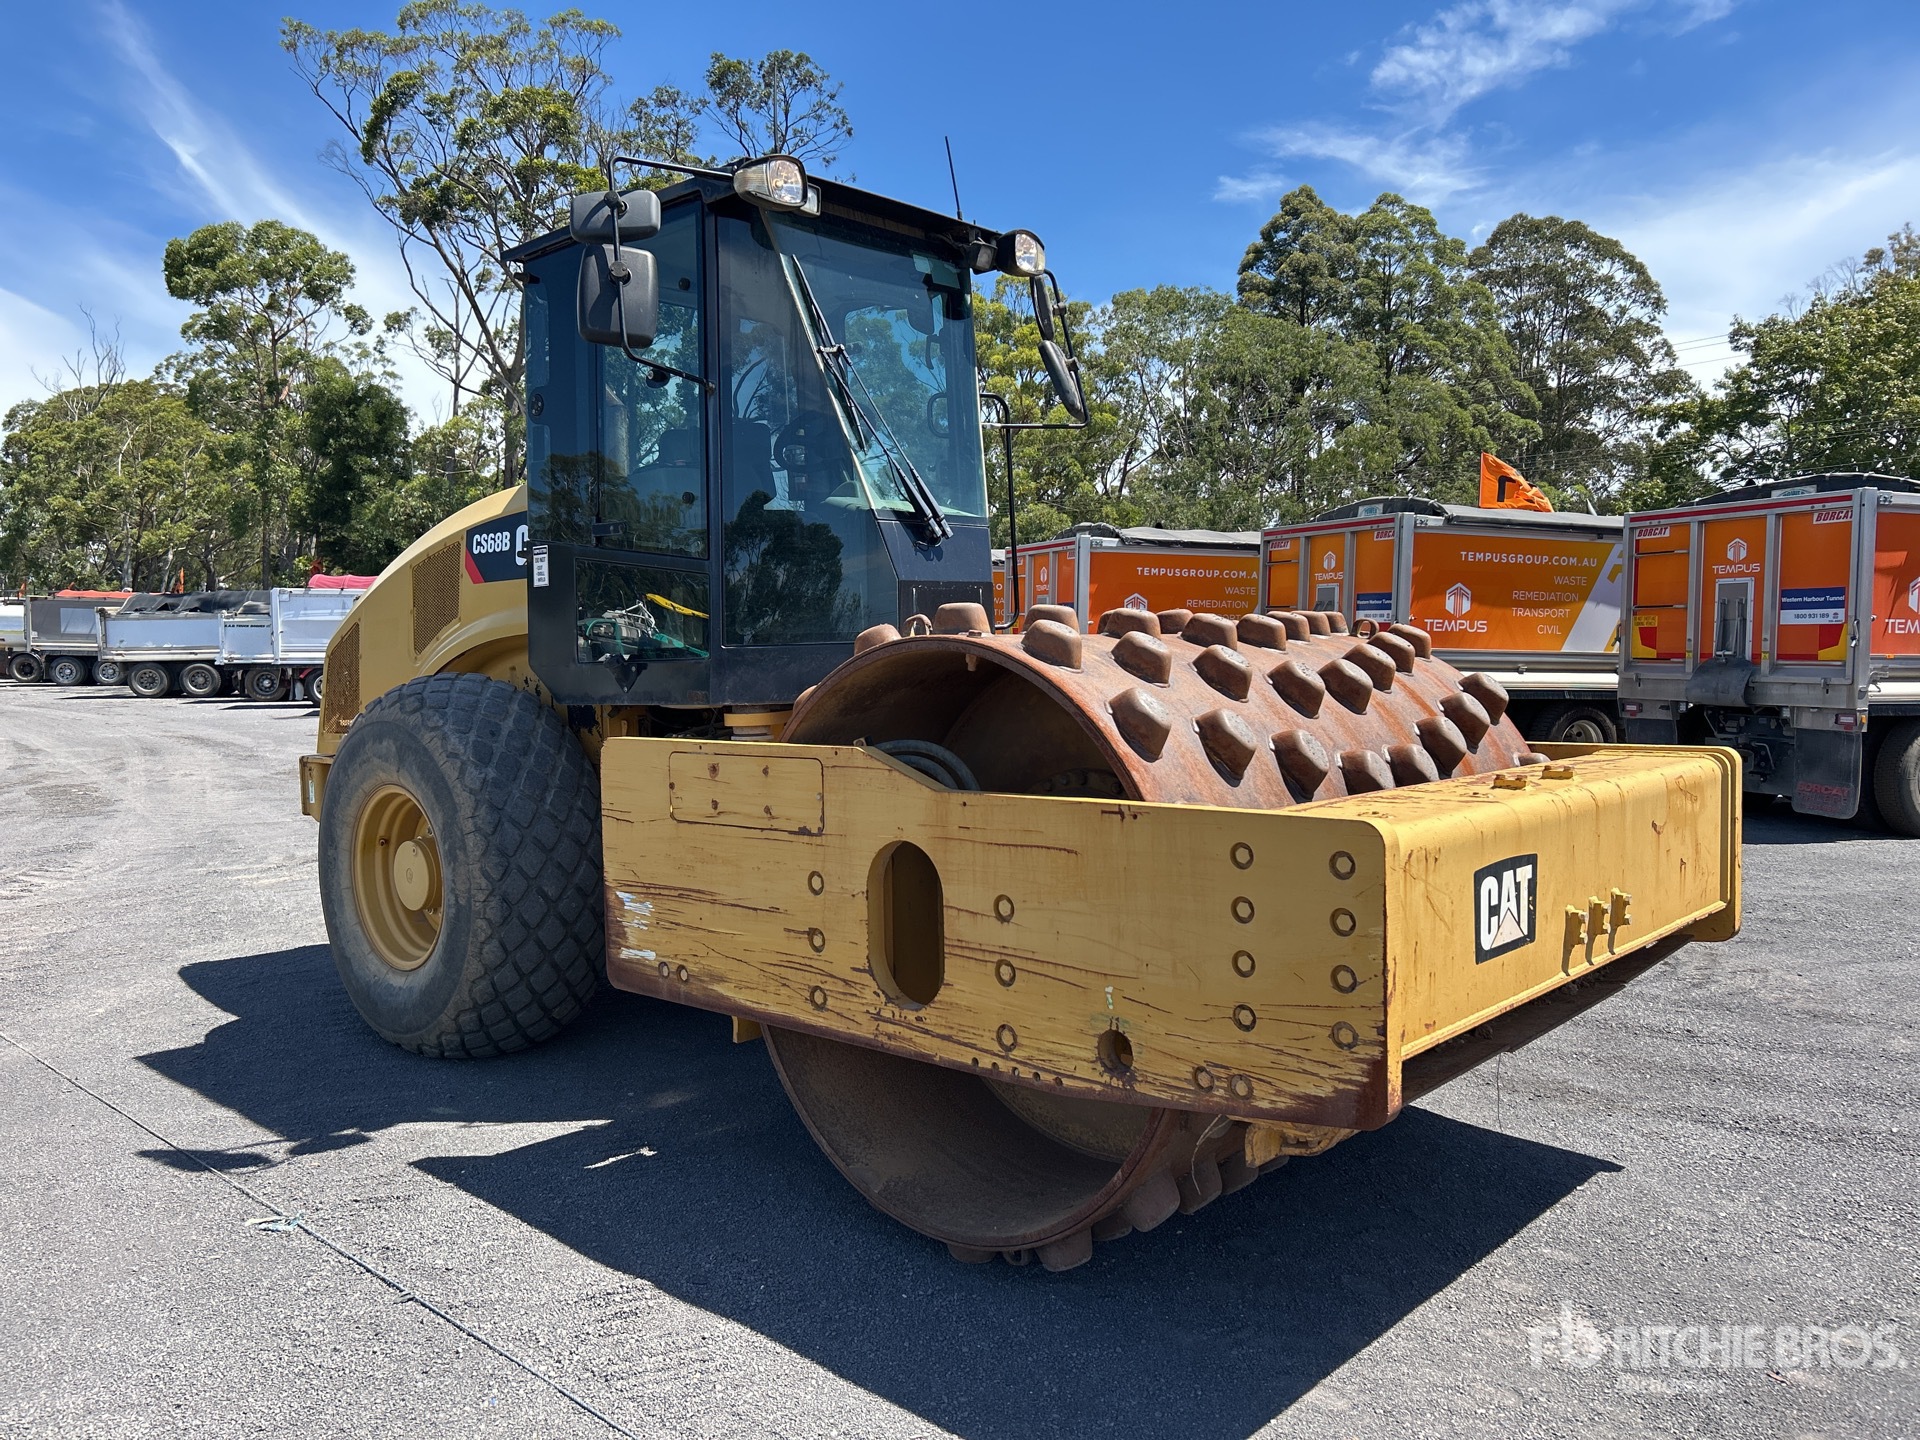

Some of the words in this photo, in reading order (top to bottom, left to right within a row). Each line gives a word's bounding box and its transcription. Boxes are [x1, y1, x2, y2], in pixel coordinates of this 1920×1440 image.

[1815, 510, 1852, 522] BORCAT
[1376, 530, 1395, 539] BORCA
[1637, 526, 1668, 538] BORCAT
[472, 531, 511, 555] CS68B
[1461, 551, 1598, 568] TEMPUSGROUP.COM.AU
[1137, 567, 1258, 579] TEMPUSGROUP.COM.A
[1712, 563, 1760, 574] TEMPUS
[1314, 571, 1344, 581] TEMPUS
[1554, 575, 1587, 586] WASTE
[1225, 586, 1257, 596] WASTE
[1512, 590, 1579, 602] REMEDIATION
[1186, 599, 1249, 609] REMEDIATION
[1512, 607, 1571, 619] TRANSPORT
[1424, 619, 1488, 633] TEMPUS
[1537, 624, 1562, 635] CIVIL
[1885, 618, 1920, 634] TEM
[1480, 864, 1532, 951] CAT
